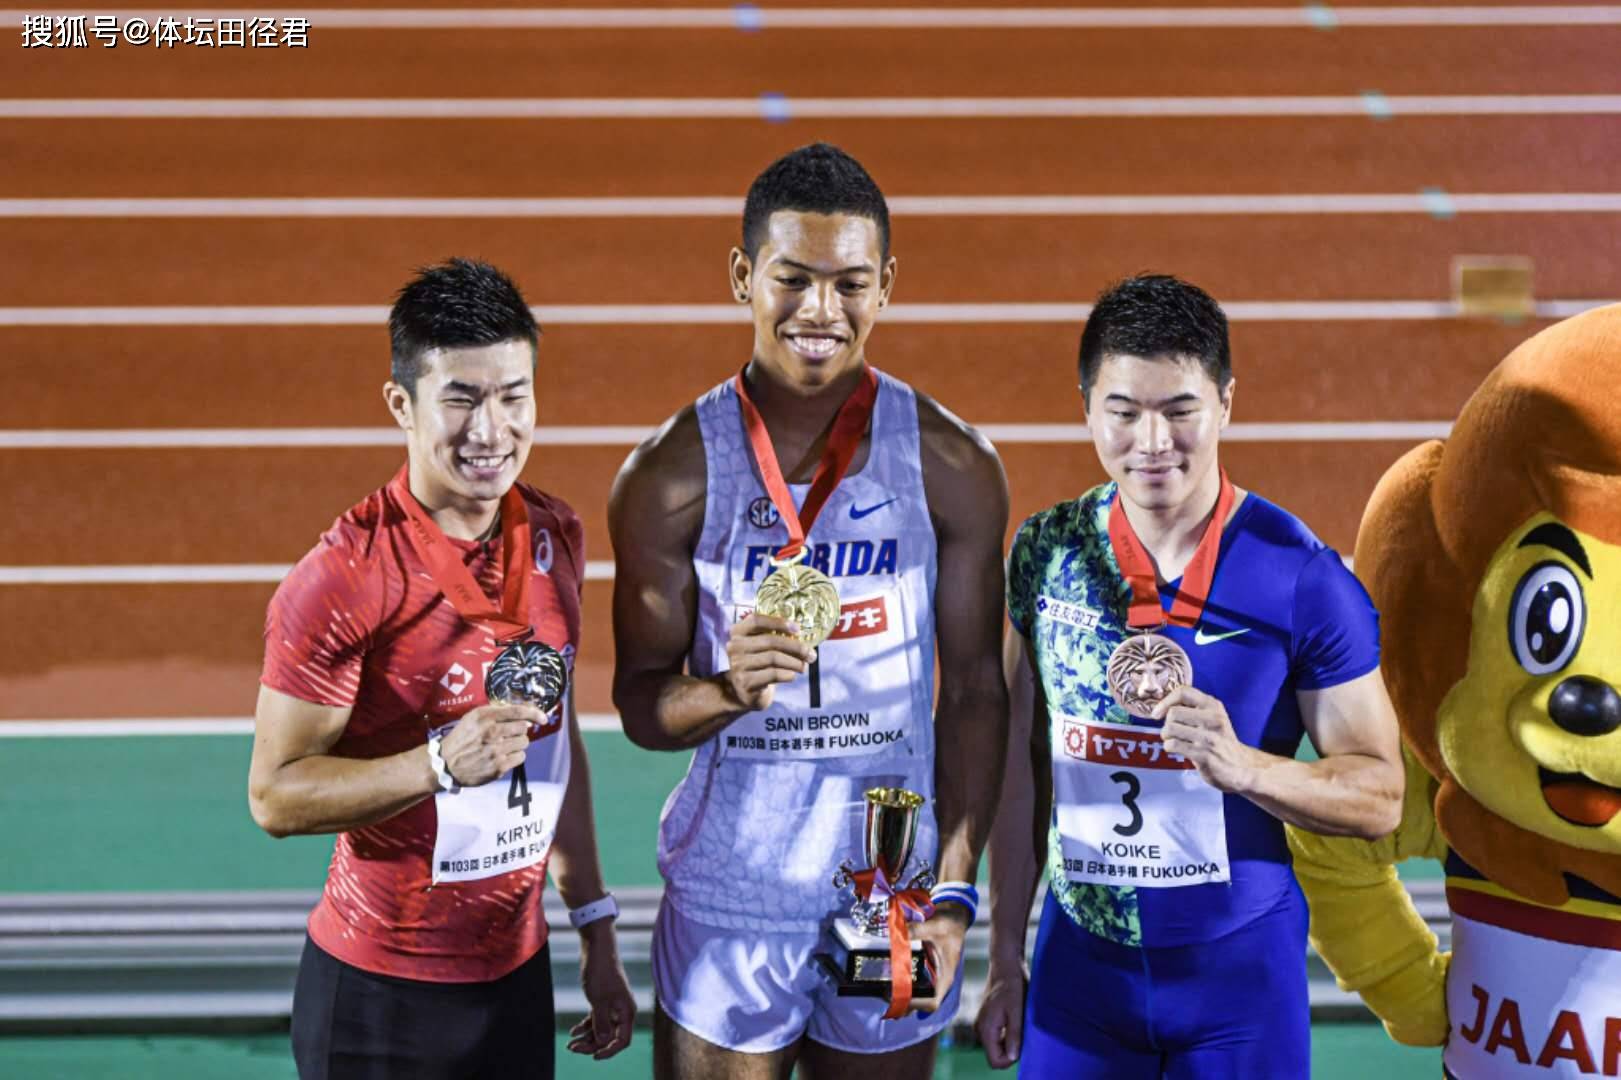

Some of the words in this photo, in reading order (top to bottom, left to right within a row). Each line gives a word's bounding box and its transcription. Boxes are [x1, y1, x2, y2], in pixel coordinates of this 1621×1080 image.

[751, 500, 778, 525] SEC
[742, 538, 898, 582] FRIDA
[764, 716, 804, 732] SANI
[808, 712, 870, 731] BROWN
[829, 729, 904, 749] FUKUOKA
[507, 762, 533, 817] 4
[1109, 771, 1144, 837] 3
[496, 818, 543, 847] KIRYU
[1101, 841, 1162, 860] KOIKE
[1142, 862, 1220, 879] FUKUOKA
